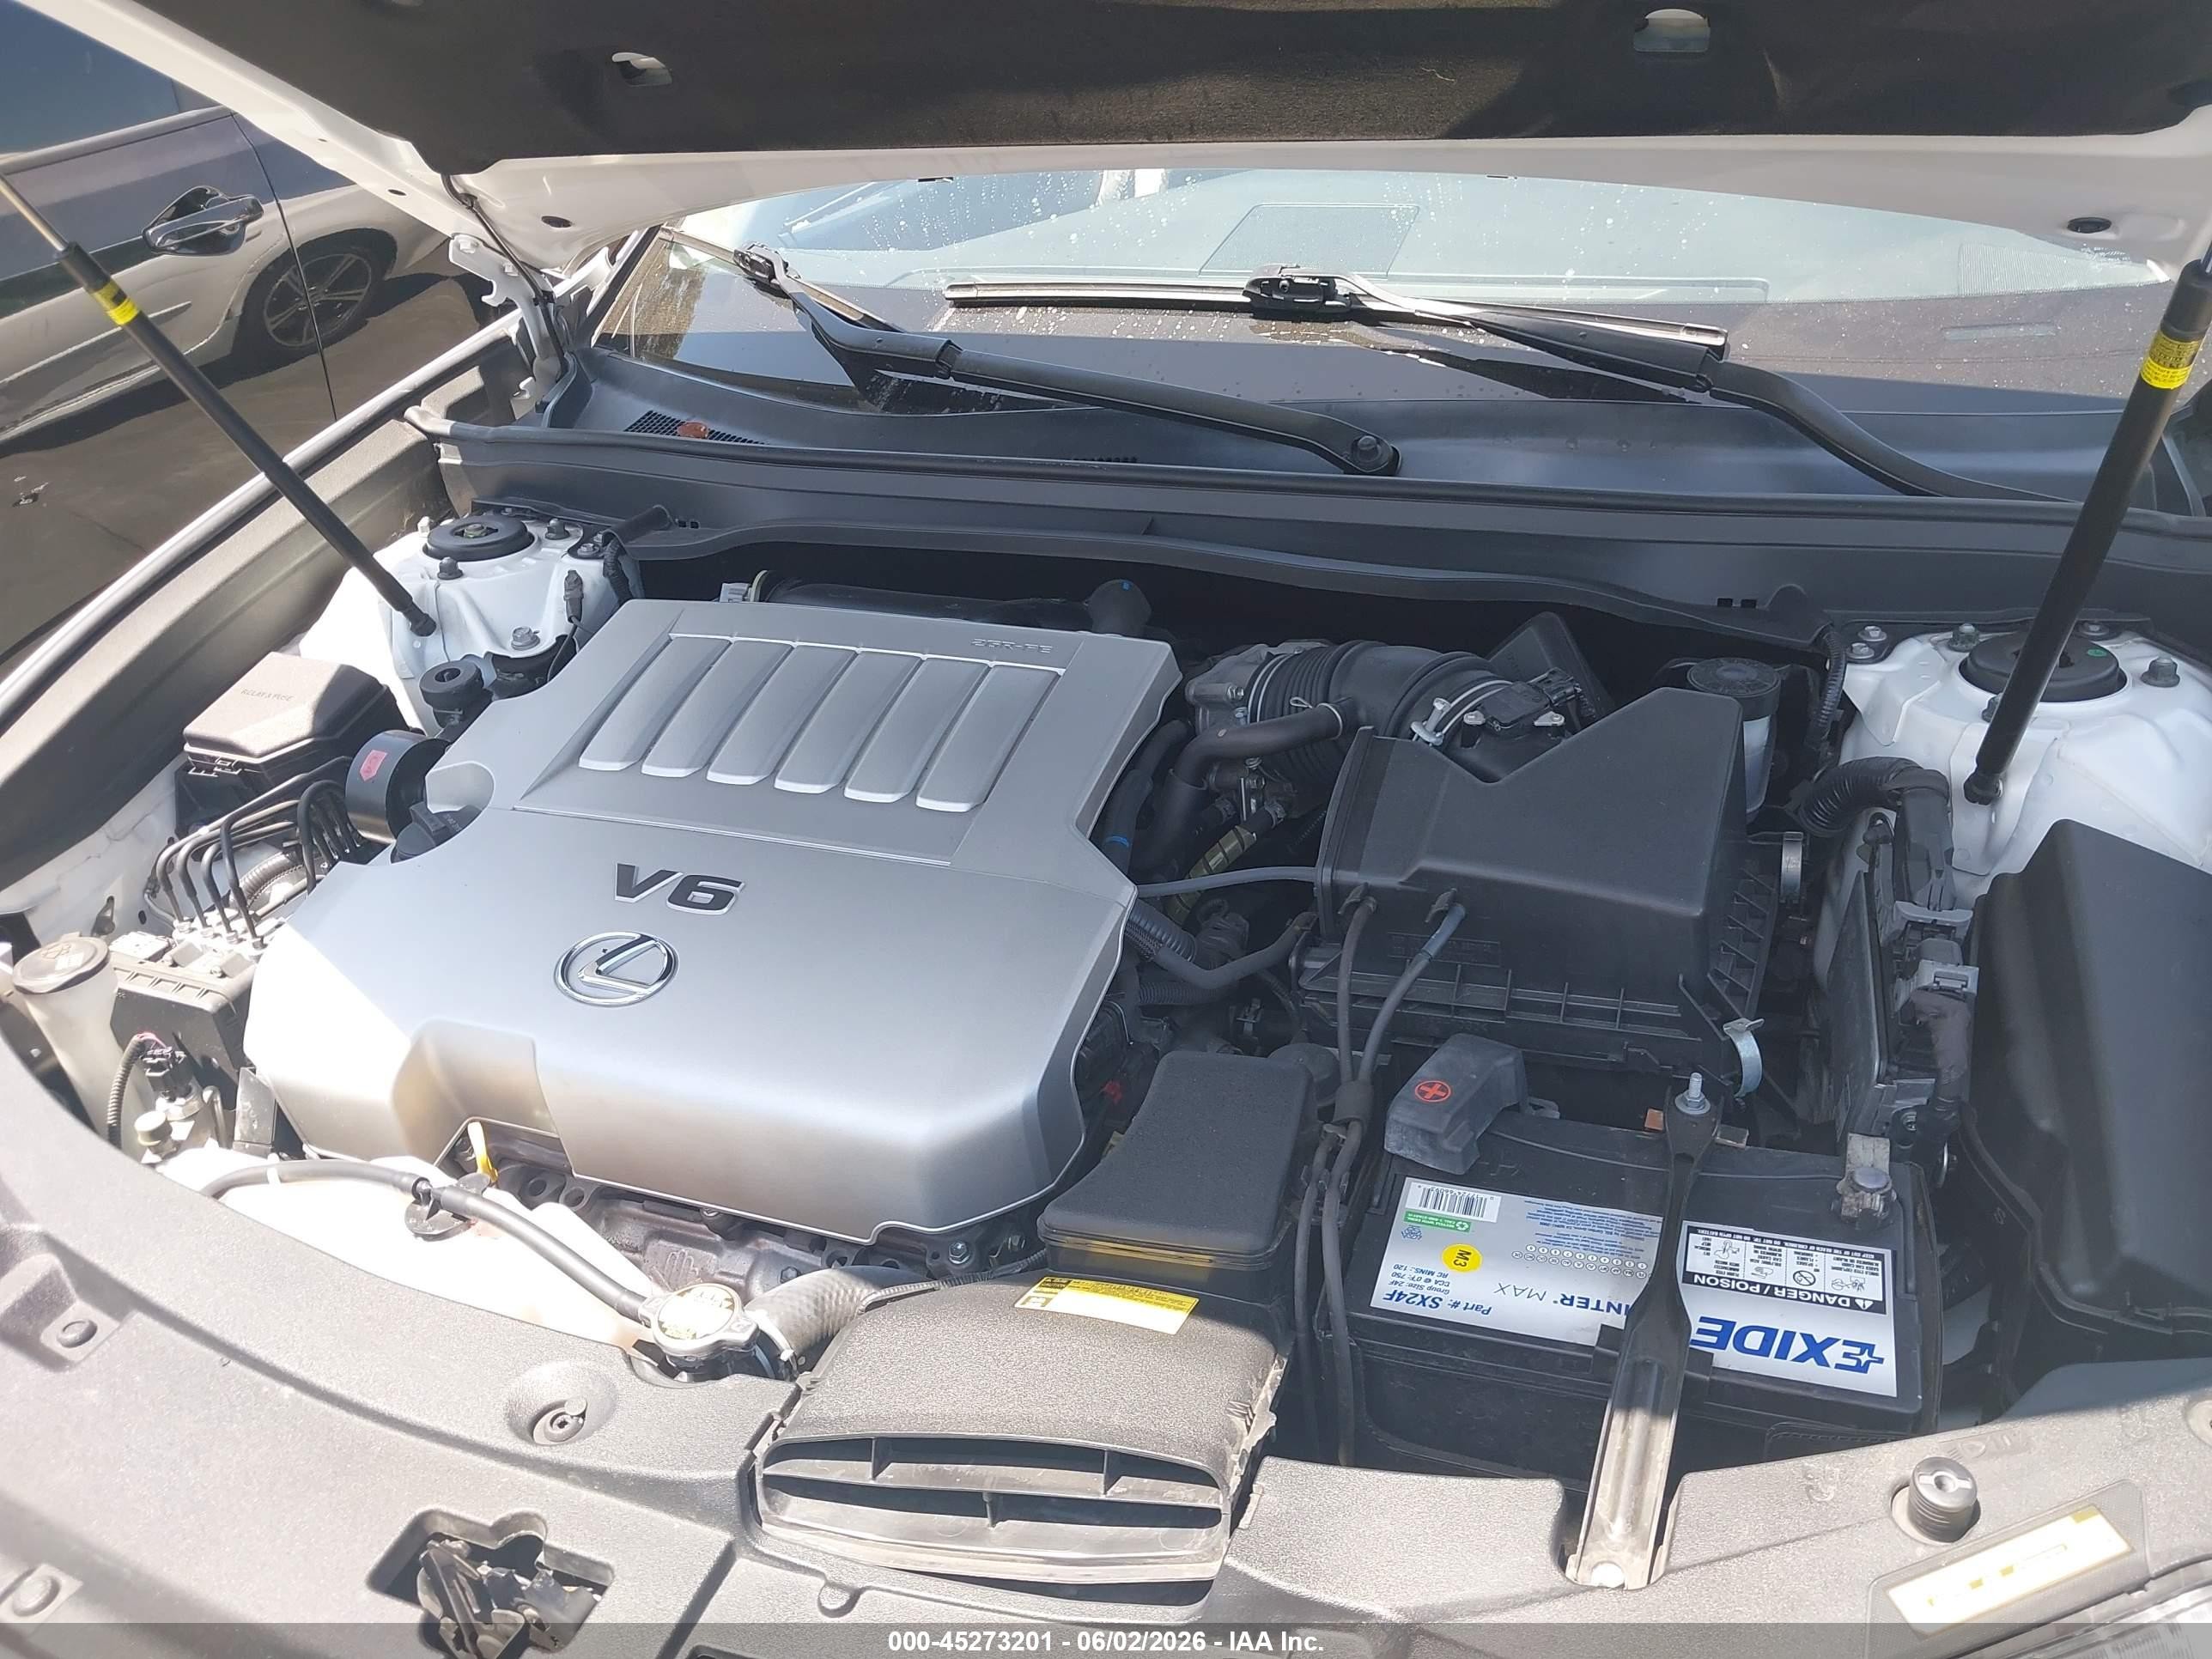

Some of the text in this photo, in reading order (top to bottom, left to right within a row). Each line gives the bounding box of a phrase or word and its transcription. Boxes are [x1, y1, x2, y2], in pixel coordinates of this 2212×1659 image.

[614, 862, 745, 916] V6
[1453, 1249, 1472, 1267] M3
[1427, 1285, 1449, 1295] Group
[1493, 1283, 1547, 1301] MAX
[1693, 1274, 1850, 1307] DANGER / POISON
[1382, 1290, 1443, 1309] SX24F
[1463, 1301, 1492, 1315] Part
[1689, 1316, 1884, 1374] EXIDE
